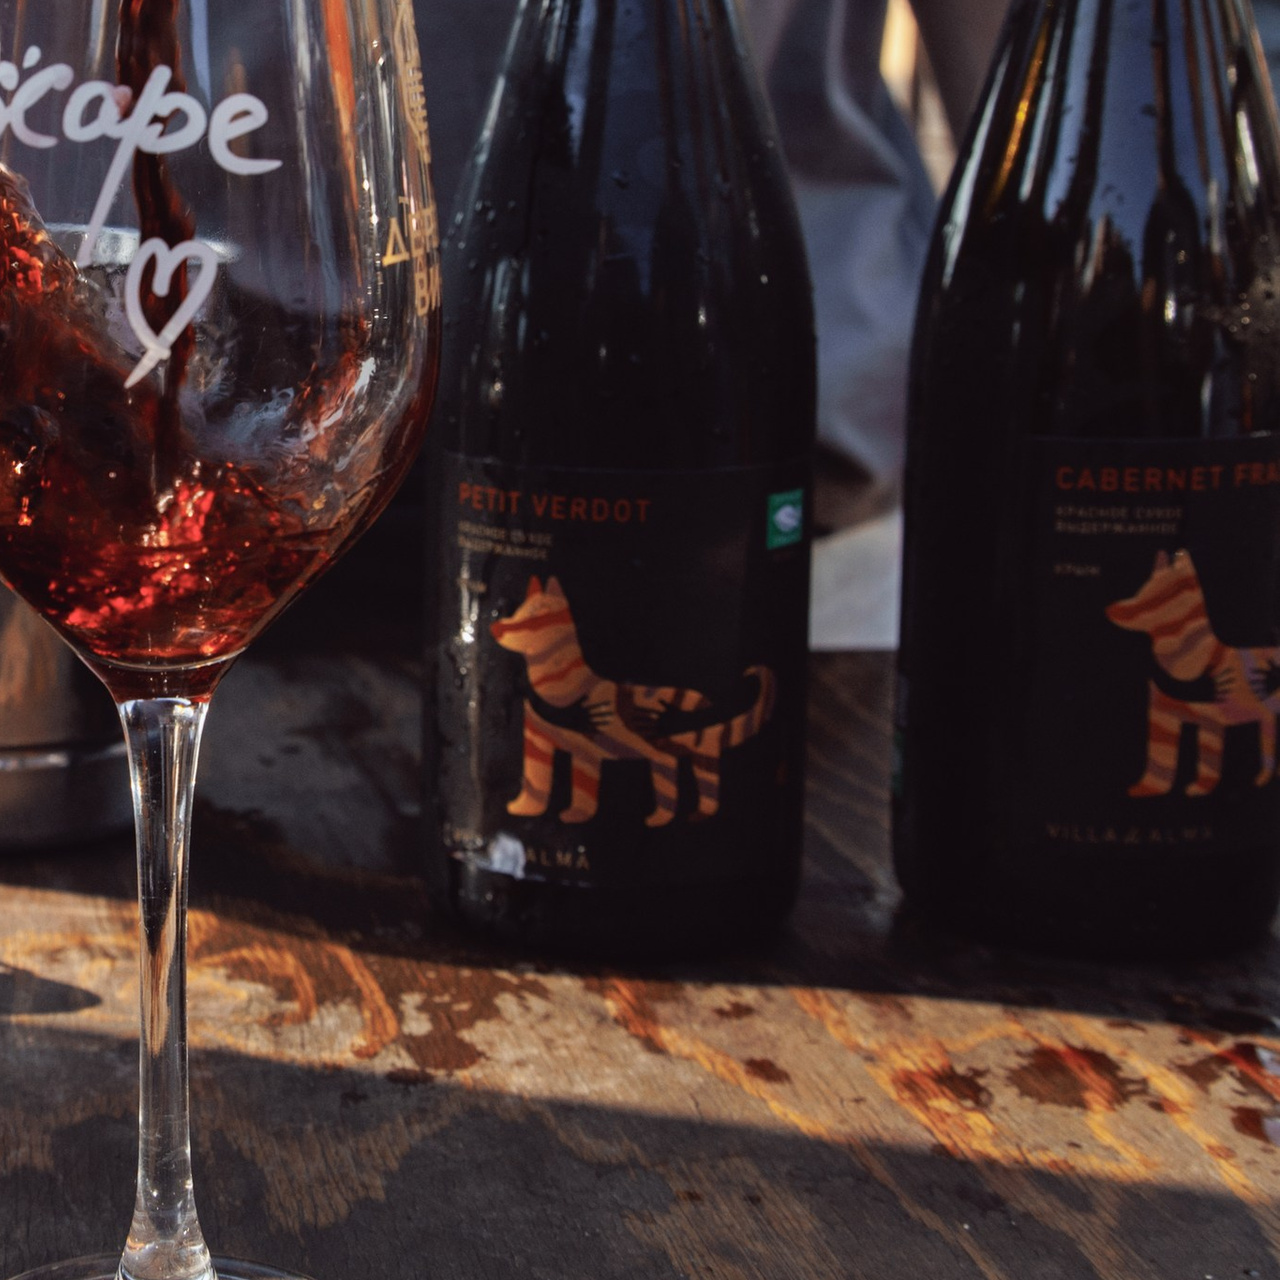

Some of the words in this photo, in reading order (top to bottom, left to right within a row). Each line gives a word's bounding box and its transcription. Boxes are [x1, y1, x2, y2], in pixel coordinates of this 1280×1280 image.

[1055, 466, 1224, 491] CABERNET
[1232, 460, 1280, 489] FRA
[458, 482, 522, 515] PETIT
[531, 493, 653, 524] VERDOT
